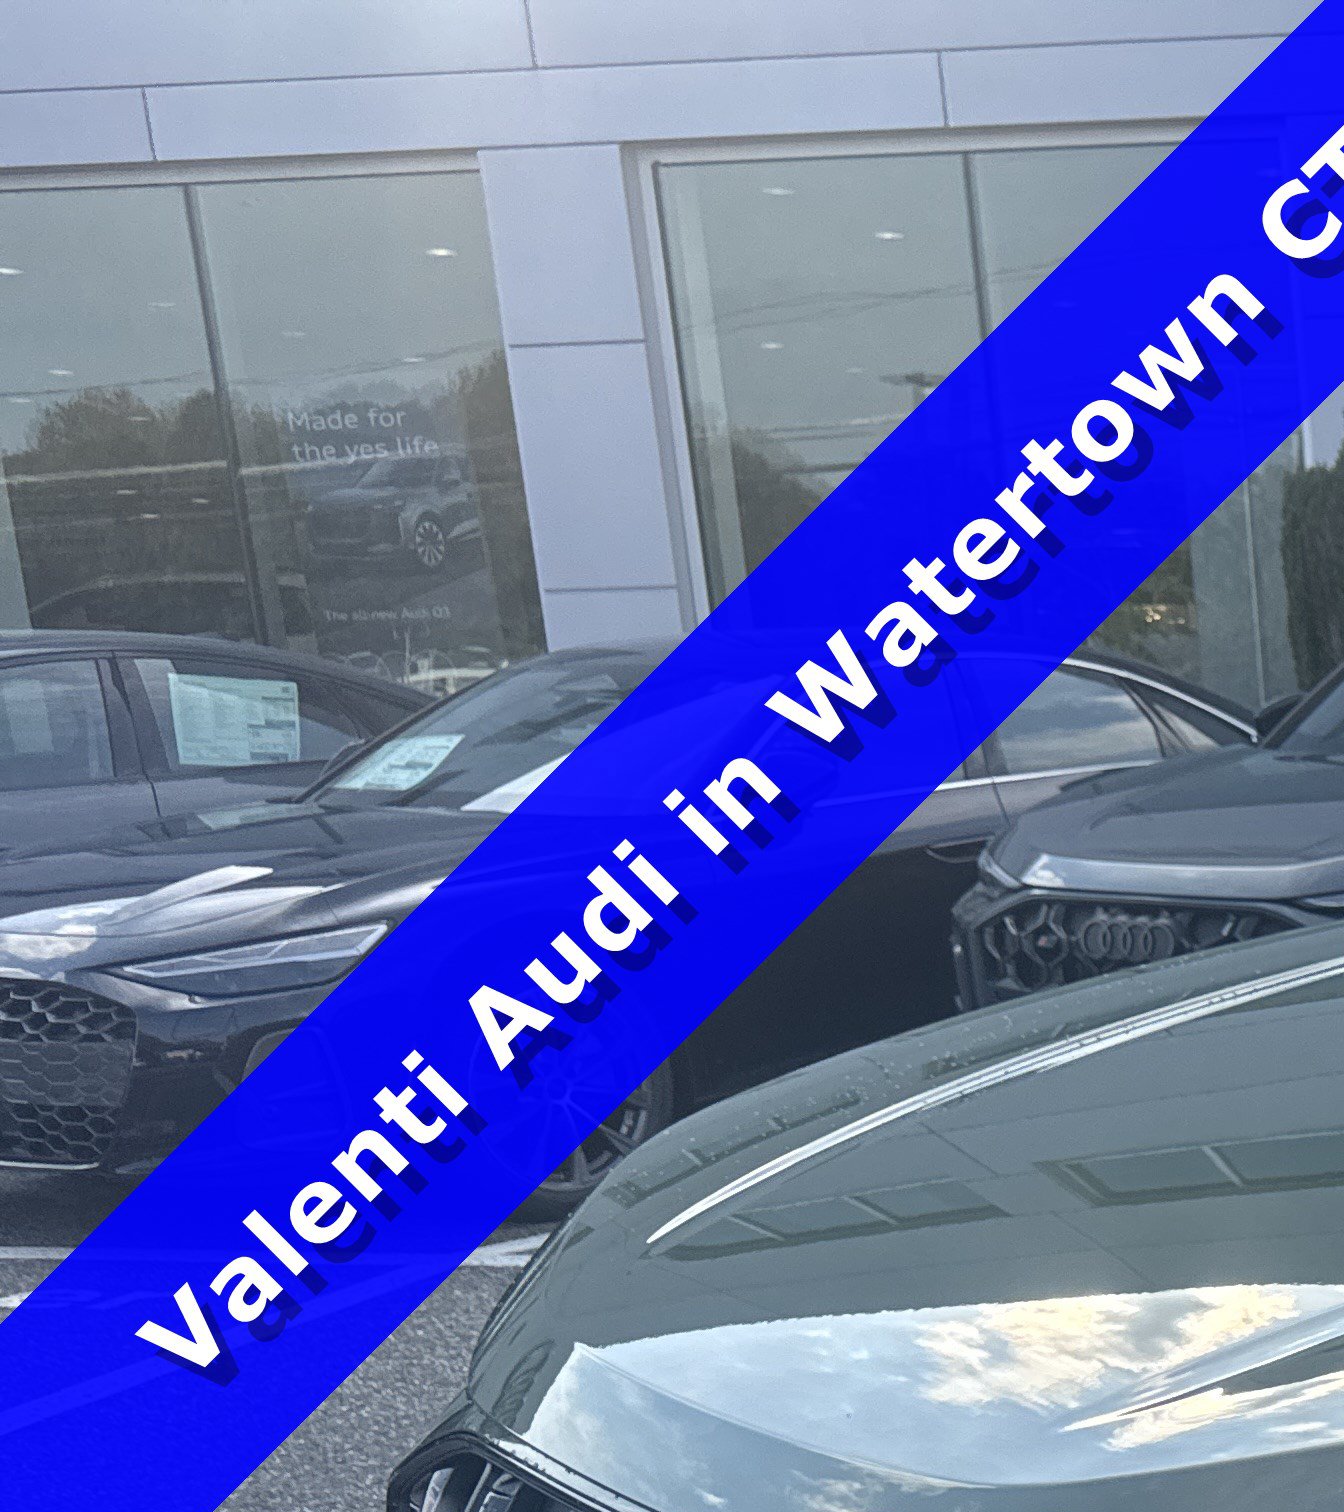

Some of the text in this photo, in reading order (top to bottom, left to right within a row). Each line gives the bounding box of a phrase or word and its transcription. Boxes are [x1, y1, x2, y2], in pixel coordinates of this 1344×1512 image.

[287, 407, 406, 432] Made for
[291, 435, 440, 464] the yes life
